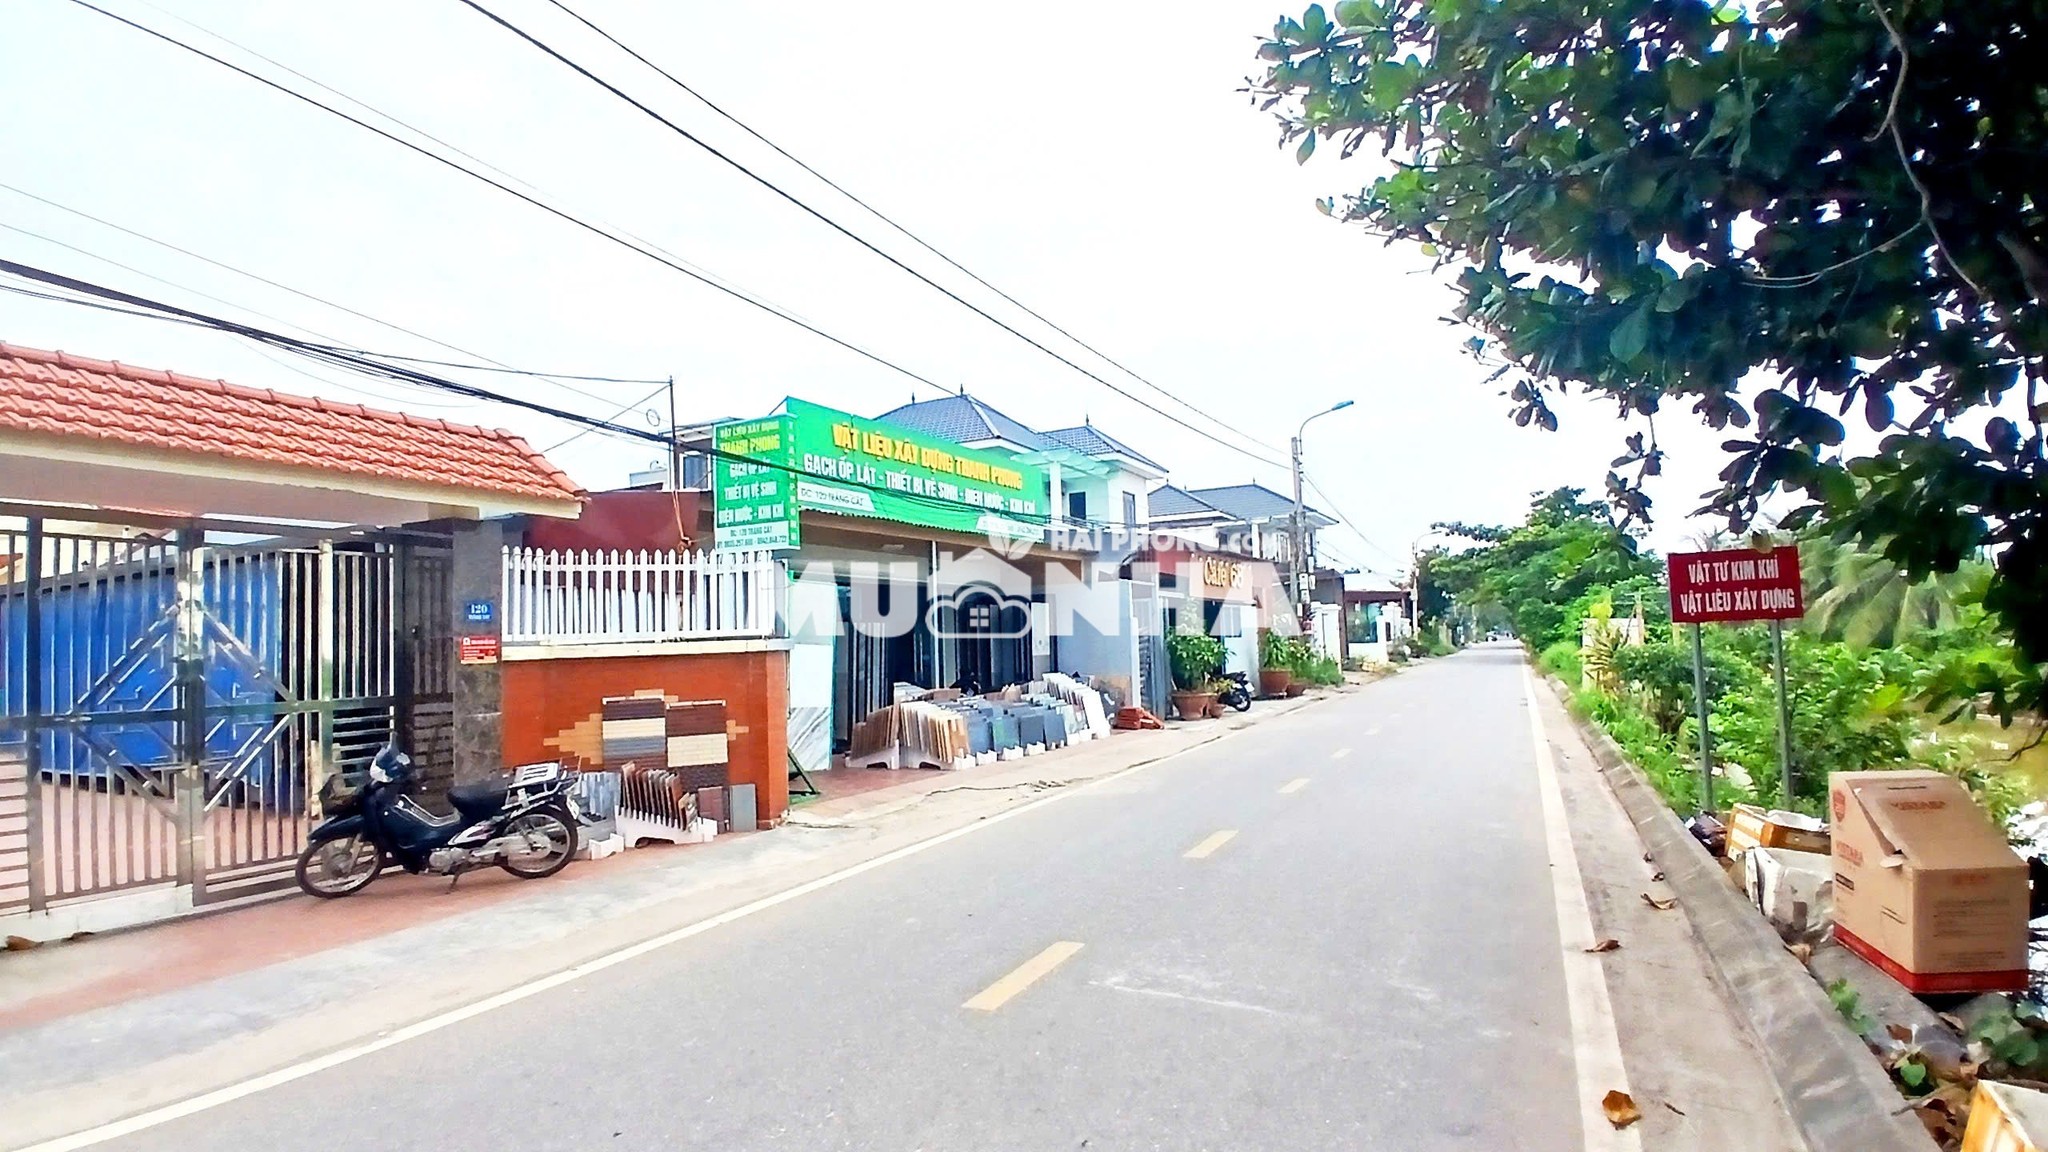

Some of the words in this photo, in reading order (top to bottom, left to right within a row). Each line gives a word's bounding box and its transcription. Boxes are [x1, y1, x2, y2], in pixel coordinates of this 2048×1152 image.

[832, 422, 859, 454] VẬT
[863, 431, 894, 462] LIỆU
[894, 439, 918, 466] XÂY
[1688, 560, 1710, 586] VẬT
[1713, 560, 1729, 582] TƯ
[1731, 560, 1756, 581] KIM
[1758, 554, 1779, 579] KHÍ
[471, 603, 488, 614] 120
[1680, 590, 1702, 616] VẬT
[1734, 587, 1757, 611] XÂY
